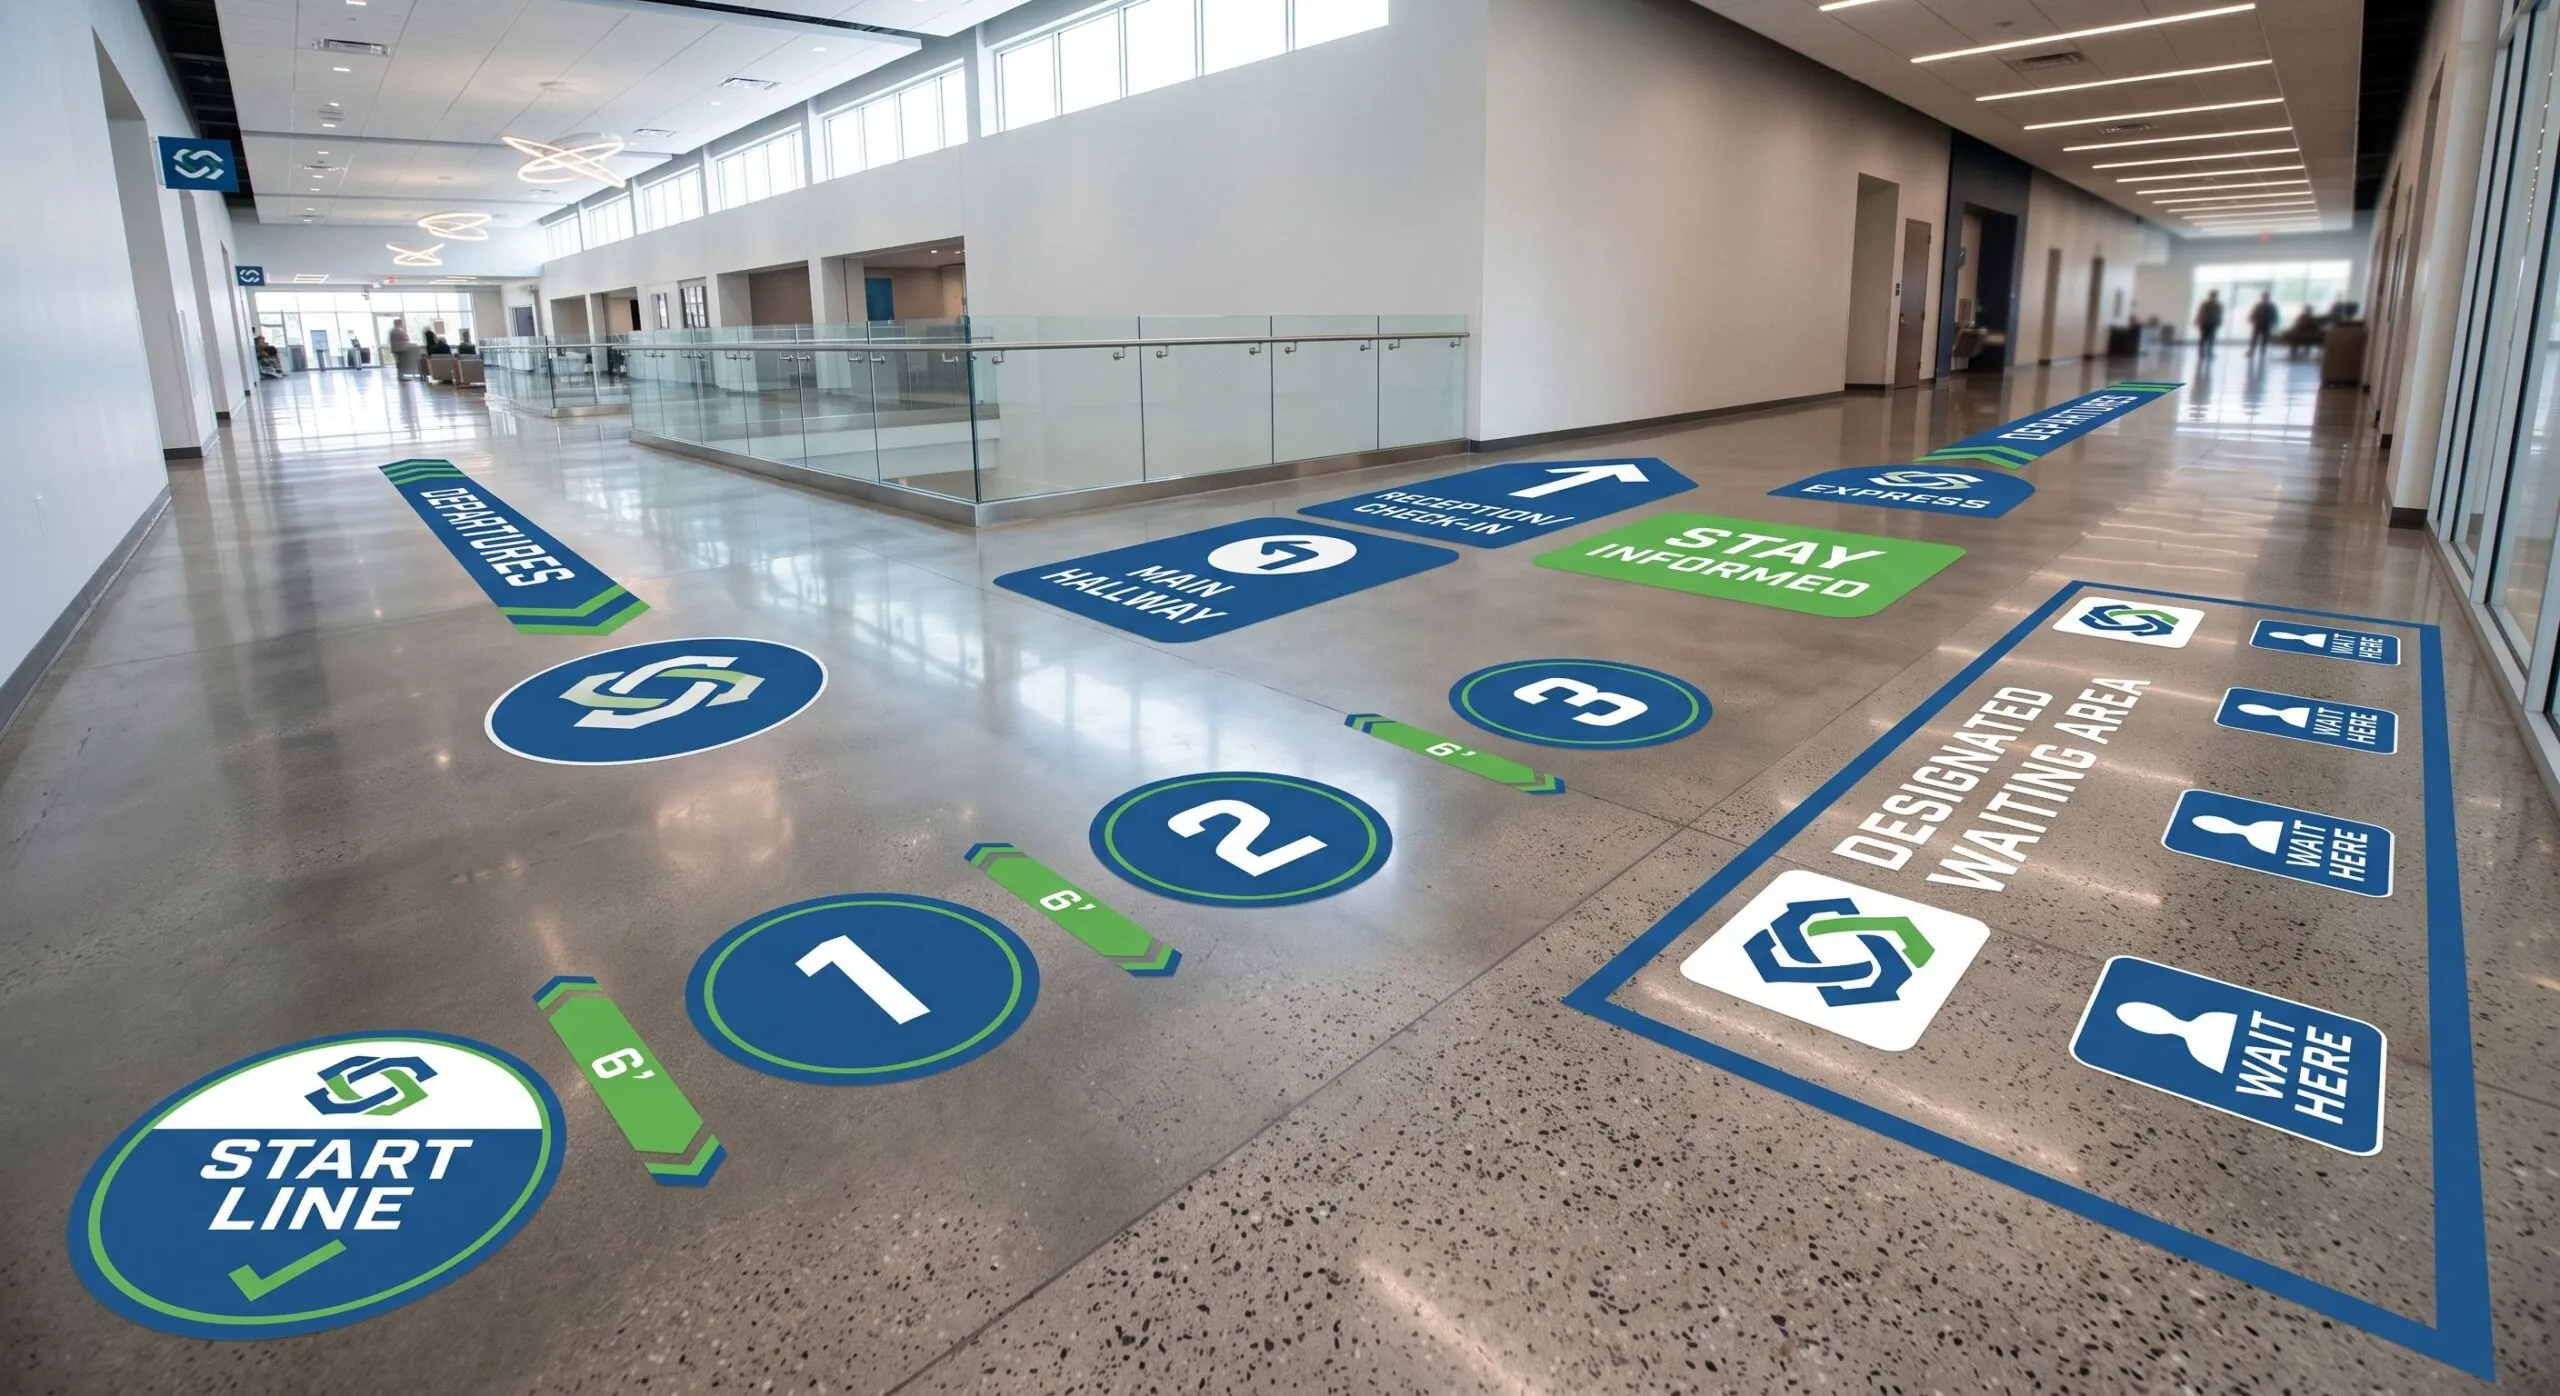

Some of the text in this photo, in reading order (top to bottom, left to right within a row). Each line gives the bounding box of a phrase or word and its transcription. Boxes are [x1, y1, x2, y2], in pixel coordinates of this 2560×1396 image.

[1997, 395, 2138, 441] DEPARTURES
[1353, 503, 1514, 535] CHECK-IN
[1375, 491, 1575, 526] RECEPTION/
[1801, 484, 1991, 509] EXPRESS
[420, 488, 576, 587] DEPARTURES
[1664, 526, 1887, 572] STAY
[1126, 565, 1236, 599] MAIN
[1585, 543, 1871, 599] INFORMED
[1041, 568, 1228, 626] HALLWAY
[2330, 633, 2356, 655] WAIT
[2358, 637, 2384, 660] HERE
[1513, 677, 1649, 727] 3
[2312, 706, 2345, 737] WAIT
[2346, 712, 2378, 745] HERE
[1831, 686, 2054, 872] DESIGNATED
[1925, 677, 2151, 893] WAITING AREA
[1167, 799, 1328, 878] 2
[2285, 819, 2327, 868] WAIT
[2328, 827, 2369, 883] HERE
[795, 934, 931, 1025] 1
[2235, 1010, 2296, 1099] WAIT
[2294, 1024, 2353, 1126] HERE
[200, 1138, 474, 1180] START
[208, 1186, 415, 1231] LINE
